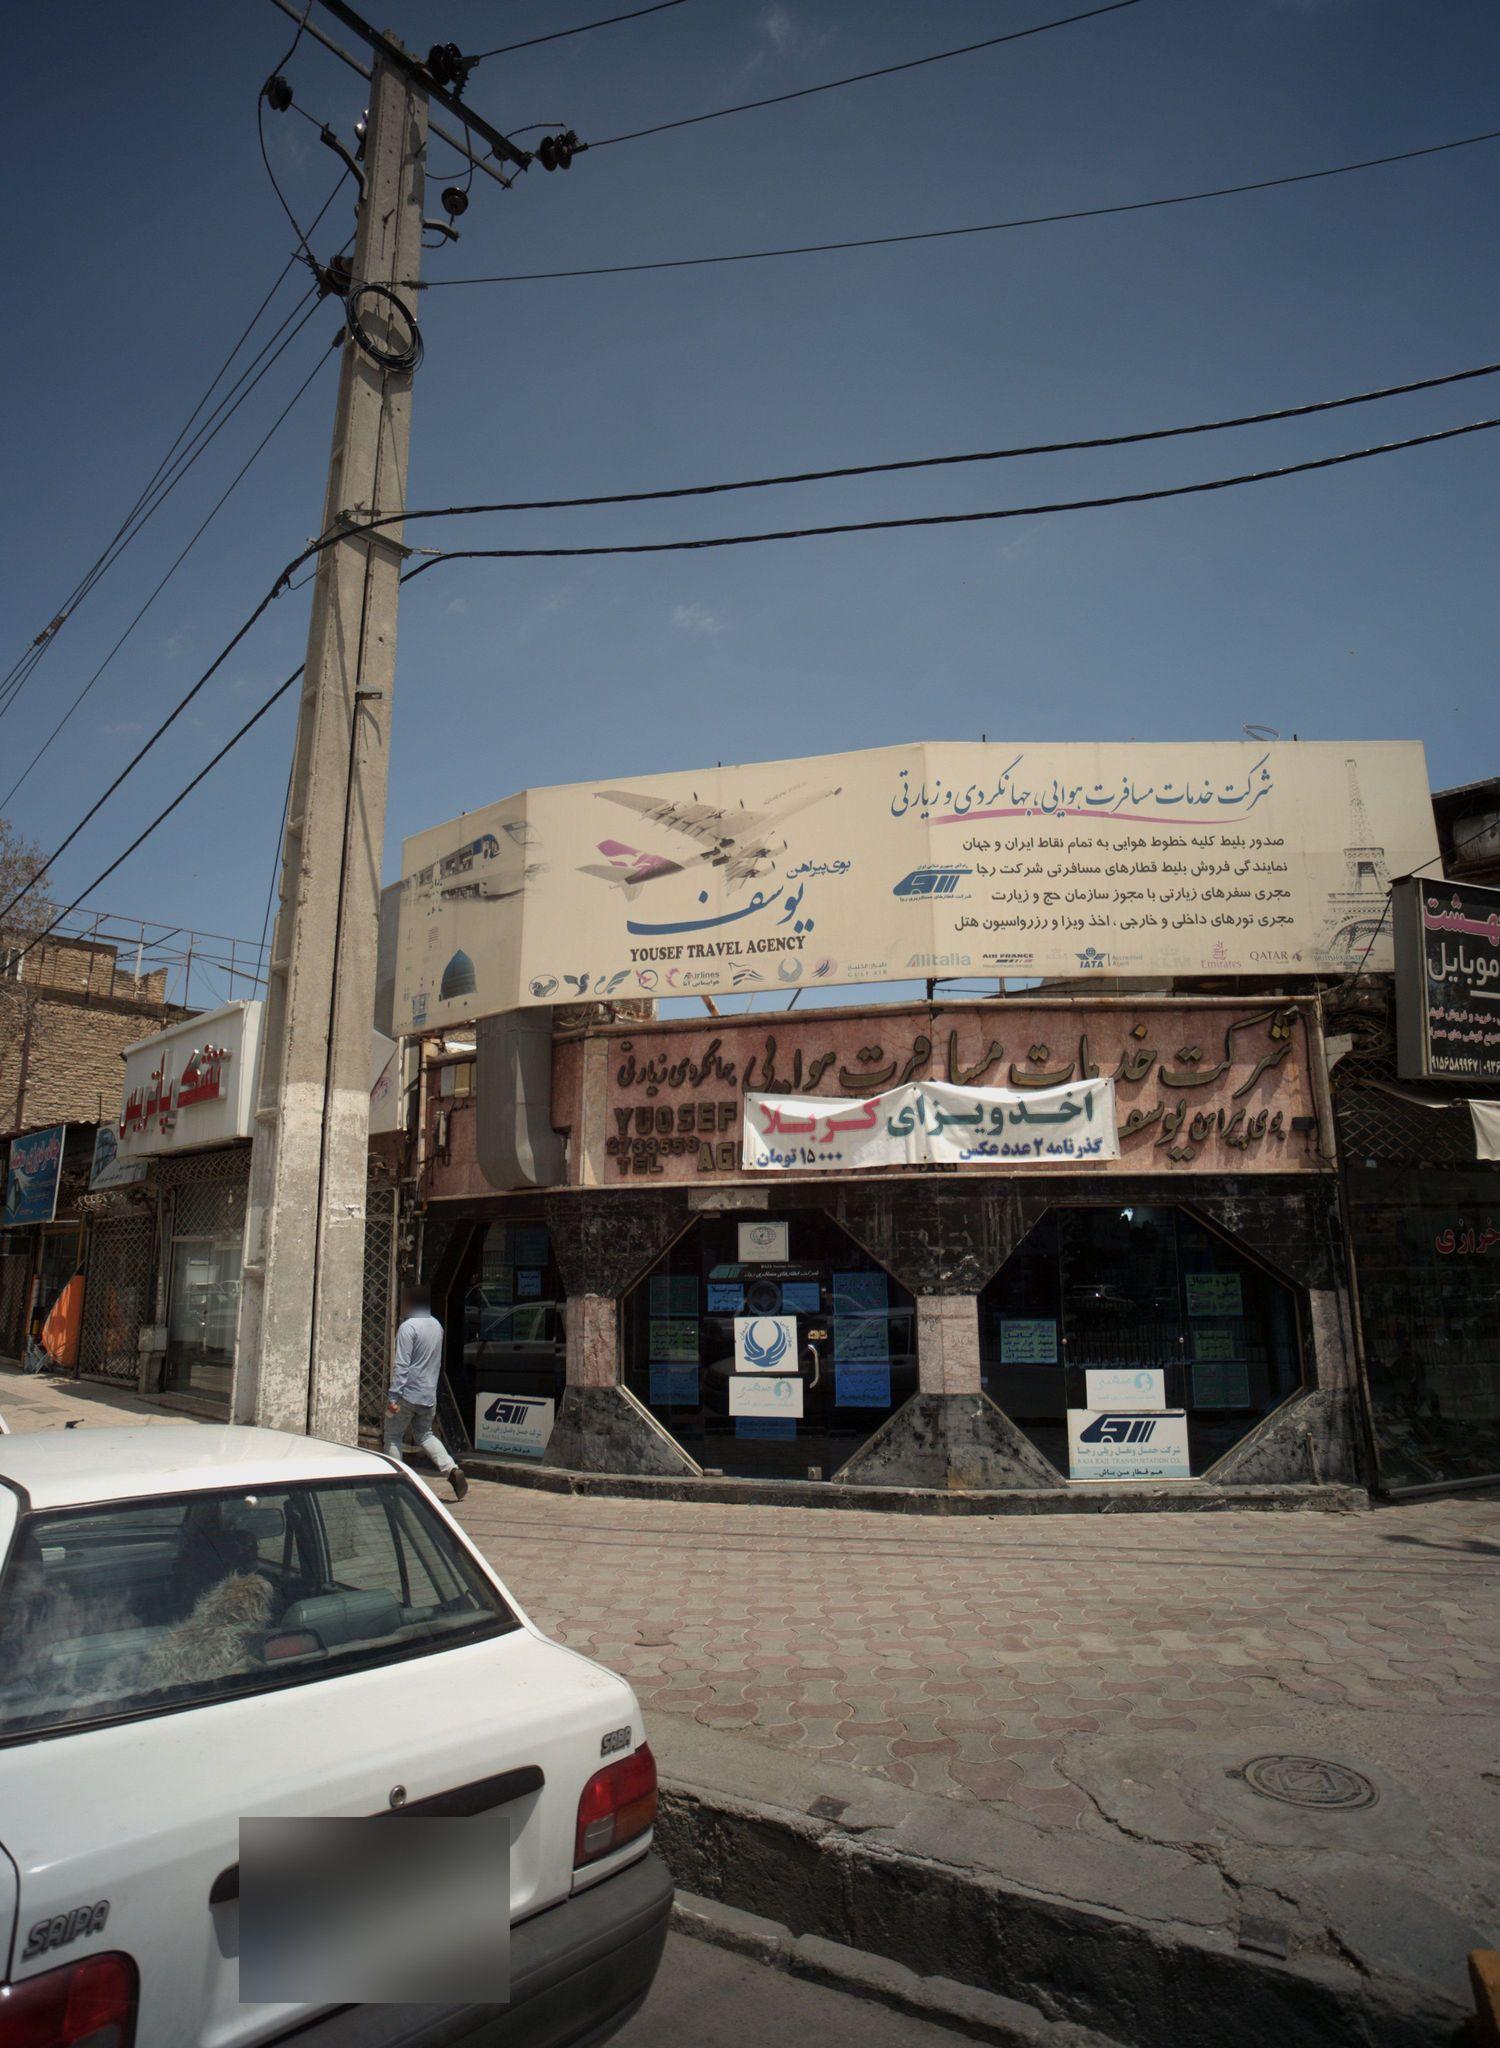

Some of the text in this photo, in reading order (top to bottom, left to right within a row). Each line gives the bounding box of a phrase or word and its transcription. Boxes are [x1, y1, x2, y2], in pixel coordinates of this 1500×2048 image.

[890, 769, 942, 819] زیارتی
[954, 753, 1031, 816] جهانگردی
[1086, 777, 1153, 813] مسافرت
[1155, 780, 1213, 805] خدمات
[1218, 752, 1273, 811] شرکت
[943, 791, 952, 806] و
[963, 835, 1284, 853] صدور بلیط کلیه خطوط هوایی به تمام نقاط ایران و جهان
[786, 859, 851, 879] بوی پیراهن
[977, 860, 1288, 877] نمایندگی فروش بلیط قطارهای مسافرتی شرکت رجا
[626, 881, 815, 936] یوسف
[991, 887, 1291, 905] مجری سفرهای زیارتی با مجوز سازمان حج و زیارت
[955, 914, 1294, 931] مجری تورهای داخلی و خارجی اخذ ویزا و رزرواسیون هتل
[630, 936, 806, 962] YOUSEF TRAVEL AGENCY
[905, 953, 971, 968] Alitalia
[1201, 960, 1242, 969] Emirates
[1250, 951, 1288, 960] QATAR
[1428, 943, 1499, 985] موبایل
[617, 1041, 668, 1097] زیارتی
[742, 1035, 836, 1094] هوایی
[840, 1030, 1004, 1088] مسافرت
[1010, 1024, 1157, 1087] خدمات
[1159, 1006, 1298, 1099] شرکت
[614, 1101, 737, 1136] YUOSEF
[760, 1091, 1093, 1143] اخذ ویزای کربلا
[1251, 1109, 1285, 1141] بوی
[617, 1154, 663, 1175] TEL
[756, 1149, 797, 1168] تومان
[959, 1137, 1103, 1160] گذرنامه ۲ عدد عکس
[600, 1725, 632, 1759] SABA
[21, 1899, 111, 1963] SAIPA
